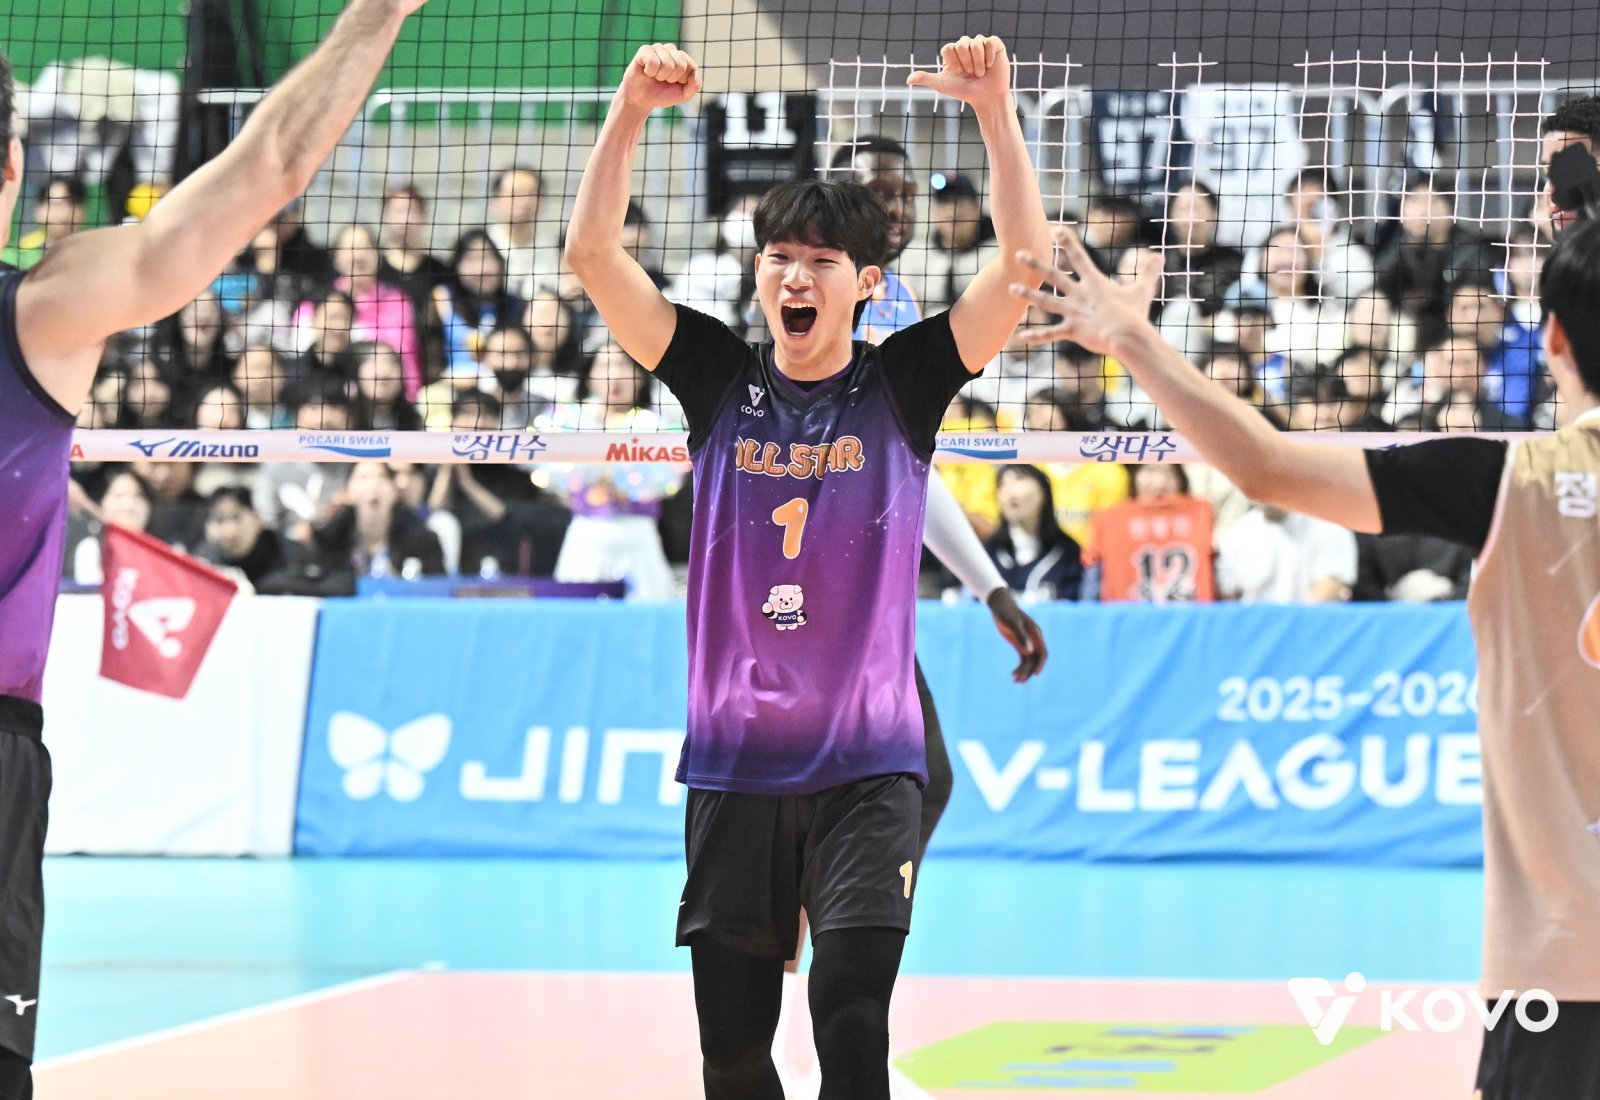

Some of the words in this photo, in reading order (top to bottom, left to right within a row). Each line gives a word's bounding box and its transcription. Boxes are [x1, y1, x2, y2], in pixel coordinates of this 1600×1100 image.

[168, 440, 259, 458] MIZUNO
[299, 435, 346, 445] POCARI
[349, 436, 390, 446] SWEAT
[452, 434, 547, 461] 삼다수
[605, 437, 690, 462] MIKAS
[935, 438, 970, 447] CARI
[973, 438, 1017, 447] SWEAT
[1079, 435, 1177, 462] 삼다수
[771, 497, 809, 559] 1
[777, 614, 797, 622] KOVO
[459, 725, 684, 807] JIN
[957, 732, 1484, 812] V-LEAGUE
[899, 860, 913, 899] 1
